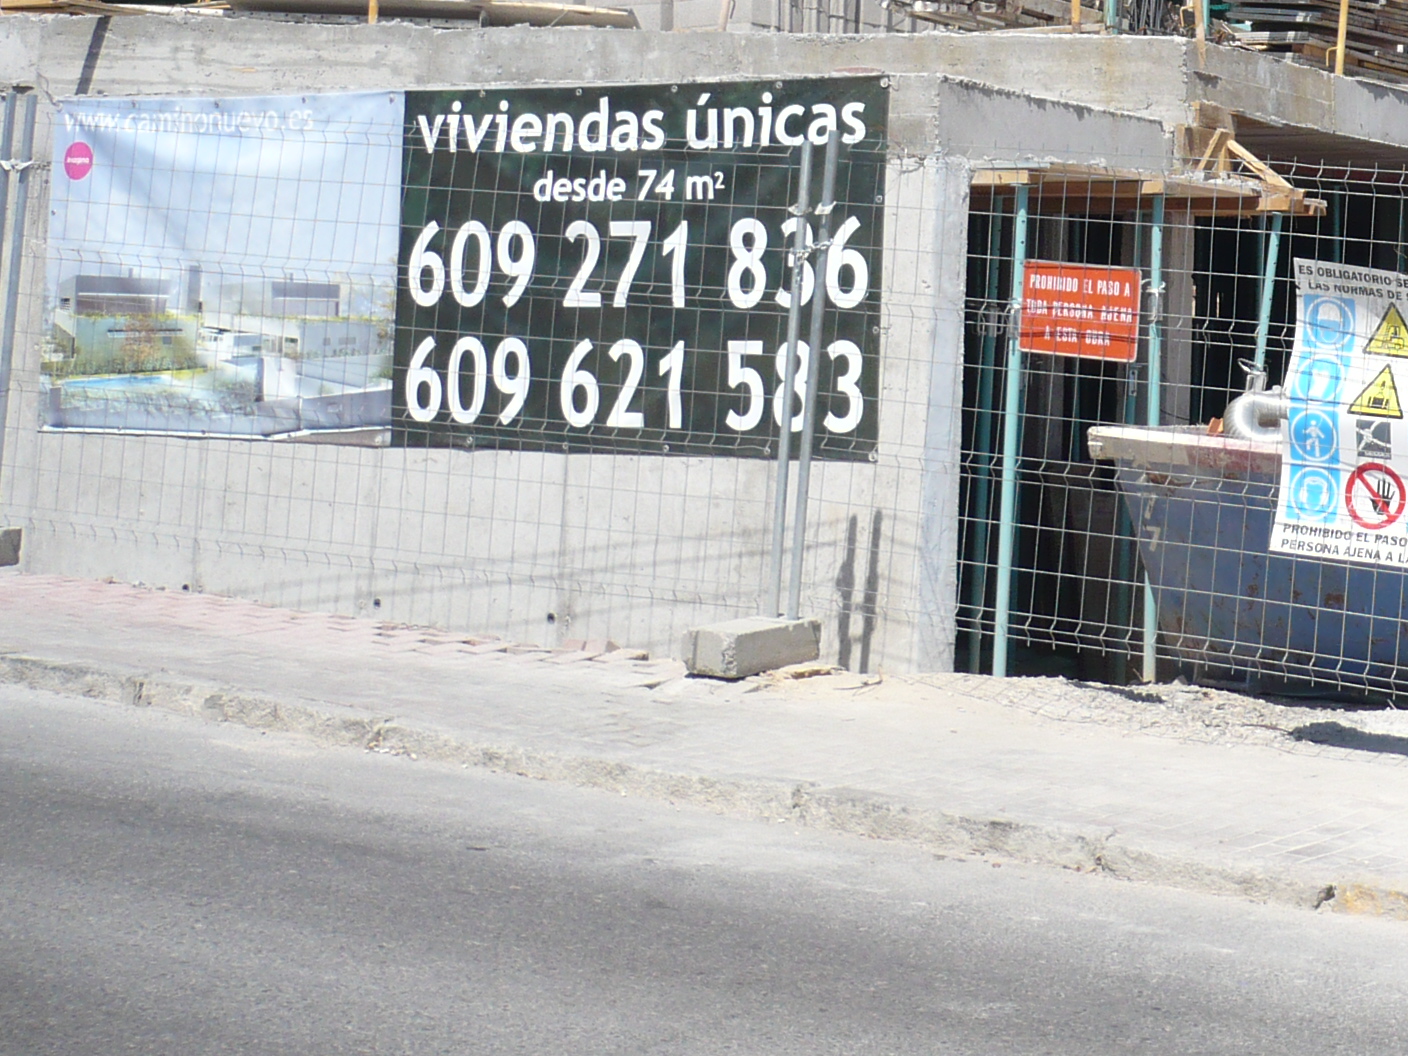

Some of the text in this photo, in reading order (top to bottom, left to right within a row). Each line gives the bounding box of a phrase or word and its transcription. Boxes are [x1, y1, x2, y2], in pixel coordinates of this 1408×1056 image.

[64, 106, 313, 134] www.caminonuevo.es
[417, 92, 867, 153] viviendas únicas
[533, 169, 627, 201] desde
[636, 169, 674, 200] 74
[408, 215, 869, 309] 609 271 836
[1029, 274, 1131, 297] PROHIBIDO EL PASO A
[1298, 265, 1313, 275] ES
[1316, 267, 1392, 286] OBLIGATORIO
[1308, 280, 1330, 291] LAS
[1334, 284, 1384, 298] NORMAS
[1387, 289, 1401, 301] DE
[1026, 298, 1133, 323] TODA PERSONA AJENA
[1044, 325, 1111, 346] A ESTA OBRA
[405, 336, 864, 434] 609 621 583
[1282, 523, 1351, 541] PROHIBIDO
[1356, 532, 1370, 543] EL
[1374, 534, 1408, 547] PASO
[1280, 538, 1340, 556] PERSONA
[1343, 547, 1382, 561] AJENA
[1385, 551, 1393, 563] A
